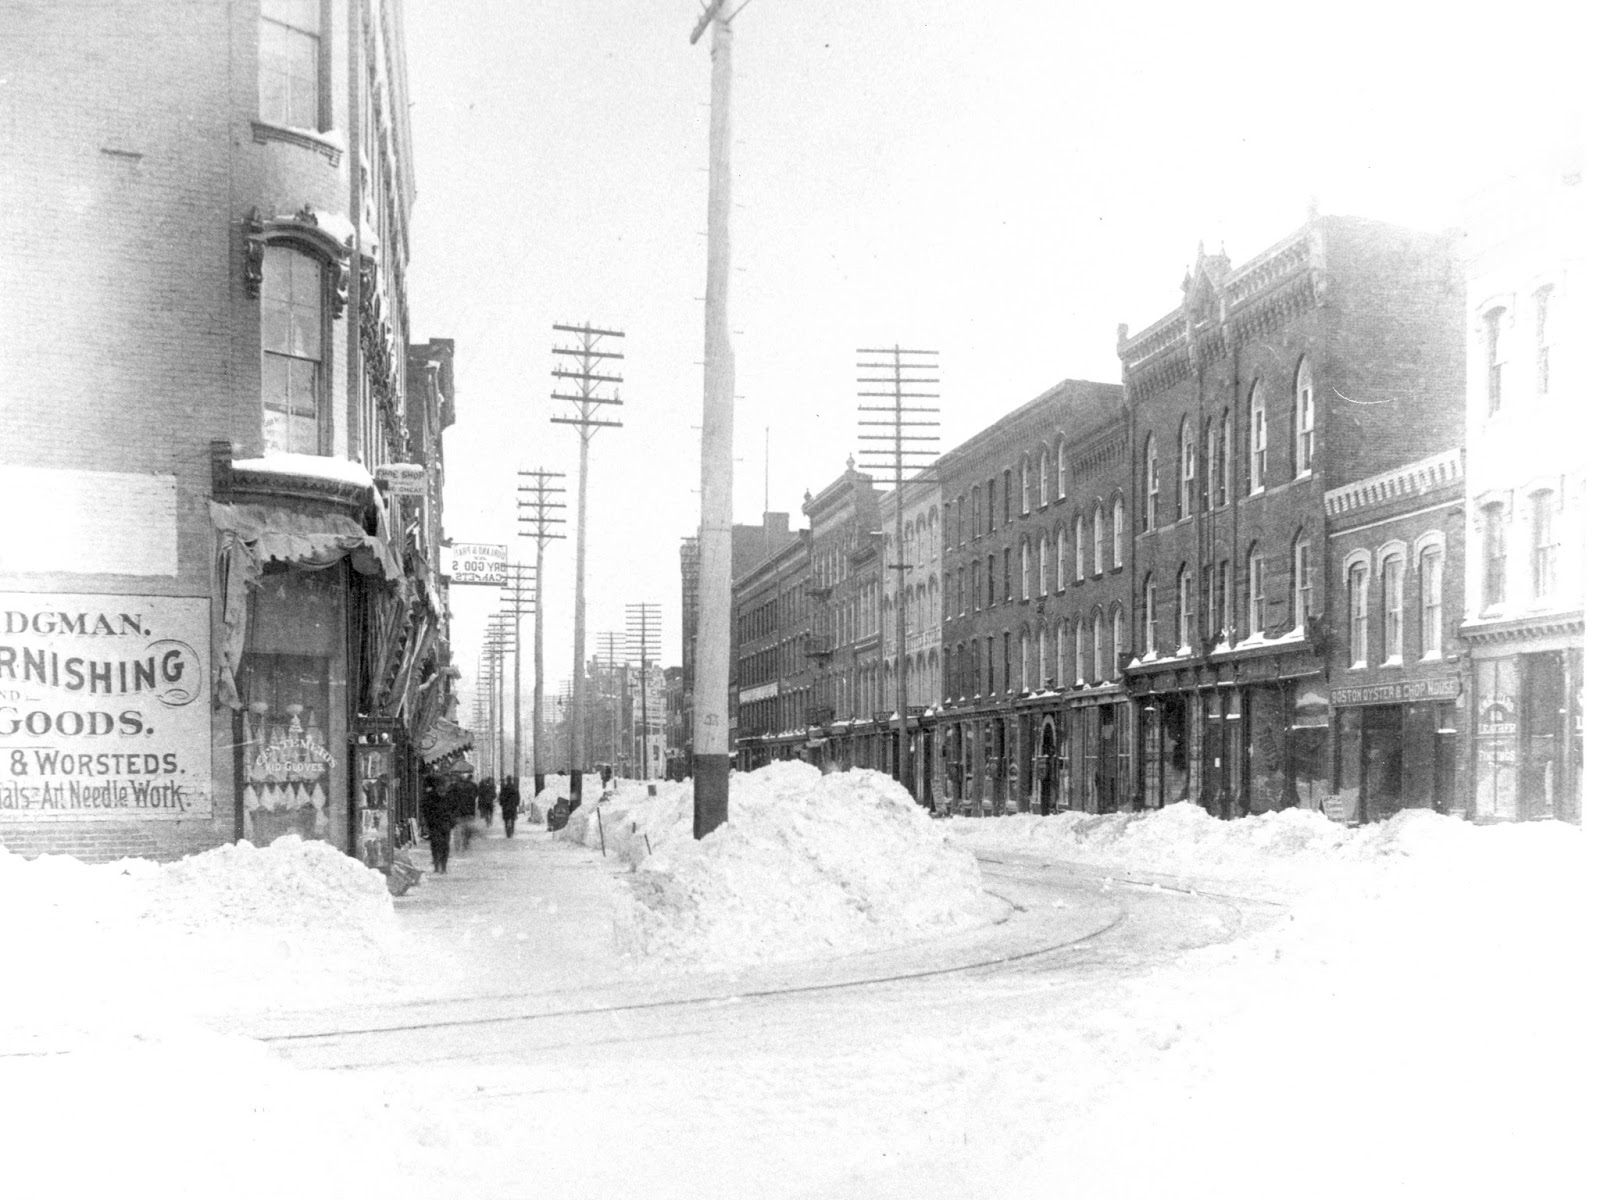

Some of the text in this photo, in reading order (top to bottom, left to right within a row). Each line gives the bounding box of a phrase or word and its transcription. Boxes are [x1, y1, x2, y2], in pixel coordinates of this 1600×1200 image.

[401, 470, 425, 479] SHOP
[0, 646, 185, 694] RNISHING
[1332, 689, 1362, 704] BOSTON
[1363, 686, 1394, 702] OYSTER
[1403, 682, 1425, 698] CHOP
[0, 707, 154, 736] GOODS.
[10, 749, 186, 777] & WORSTEDS.
[69, 780, 128, 809] Needle
[129, 780, 192, 812] Work.
